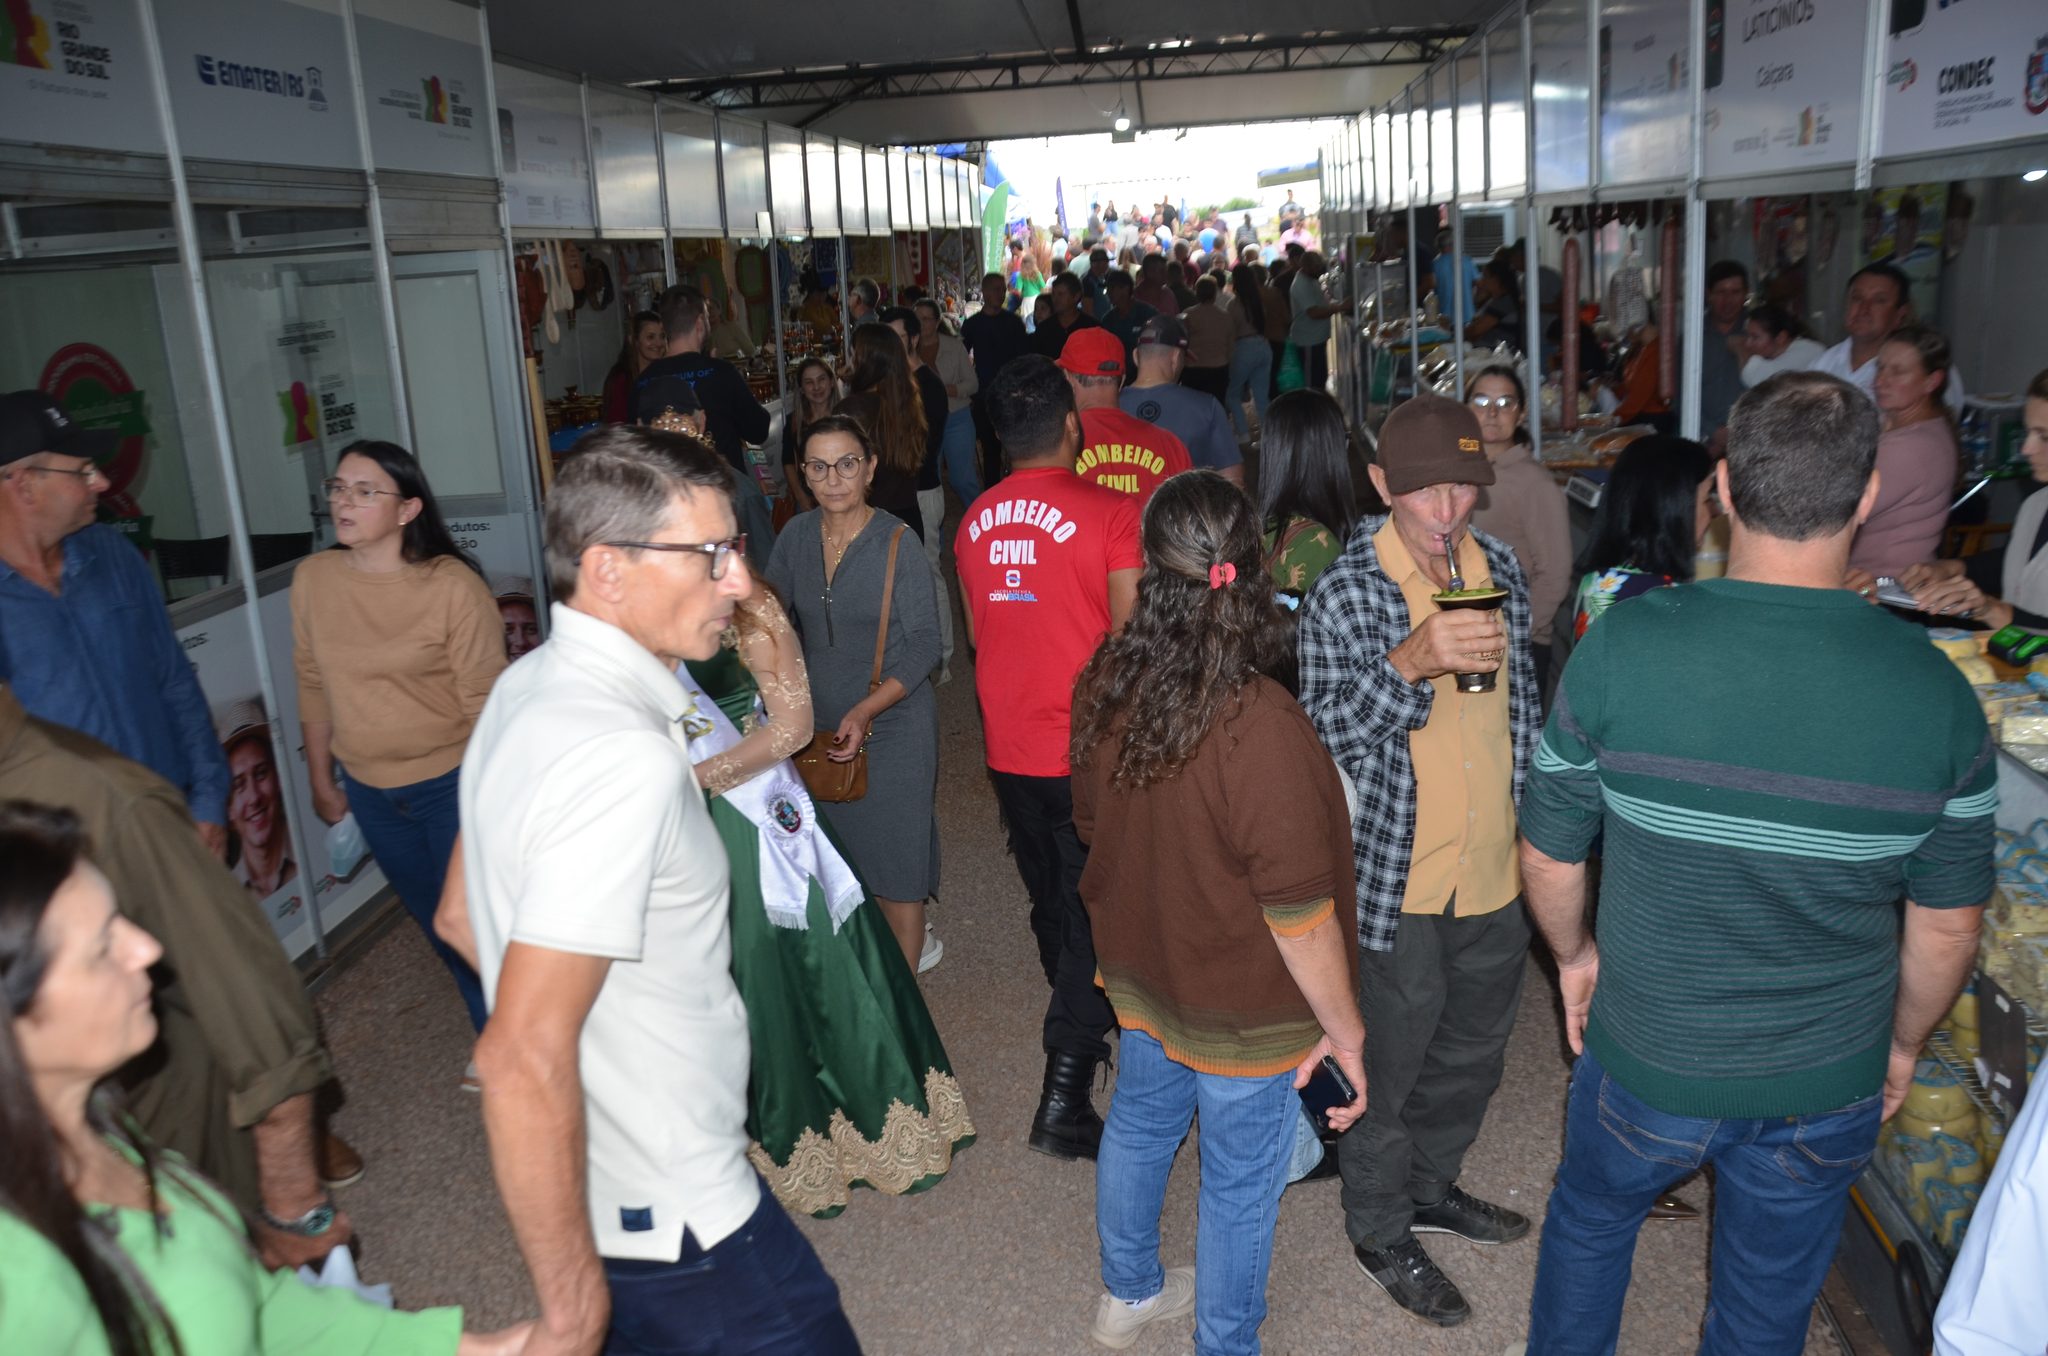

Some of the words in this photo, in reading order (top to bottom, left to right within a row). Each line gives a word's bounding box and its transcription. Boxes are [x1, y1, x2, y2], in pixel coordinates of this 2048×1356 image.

[56, 20, 80, 39] RIO
[60, 40, 112, 63] GRANDE
[65, 58, 85, 76] DO
[86, 62, 111, 80] SUL
[218, 60, 305, 98] EMATER/RS
[1937, 55, 1996, 95] CONDEC
[321, 392, 336, 407] RIO
[324, 402, 356, 421] GRANDE
[1076, 444, 1165, 476] BOMBEIRO
[1097, 474, 1140, 493] CIVIL
[968, 499, 1077, 544] BOMBEIRO
[989, 539, 1037, 565] CIVIL
